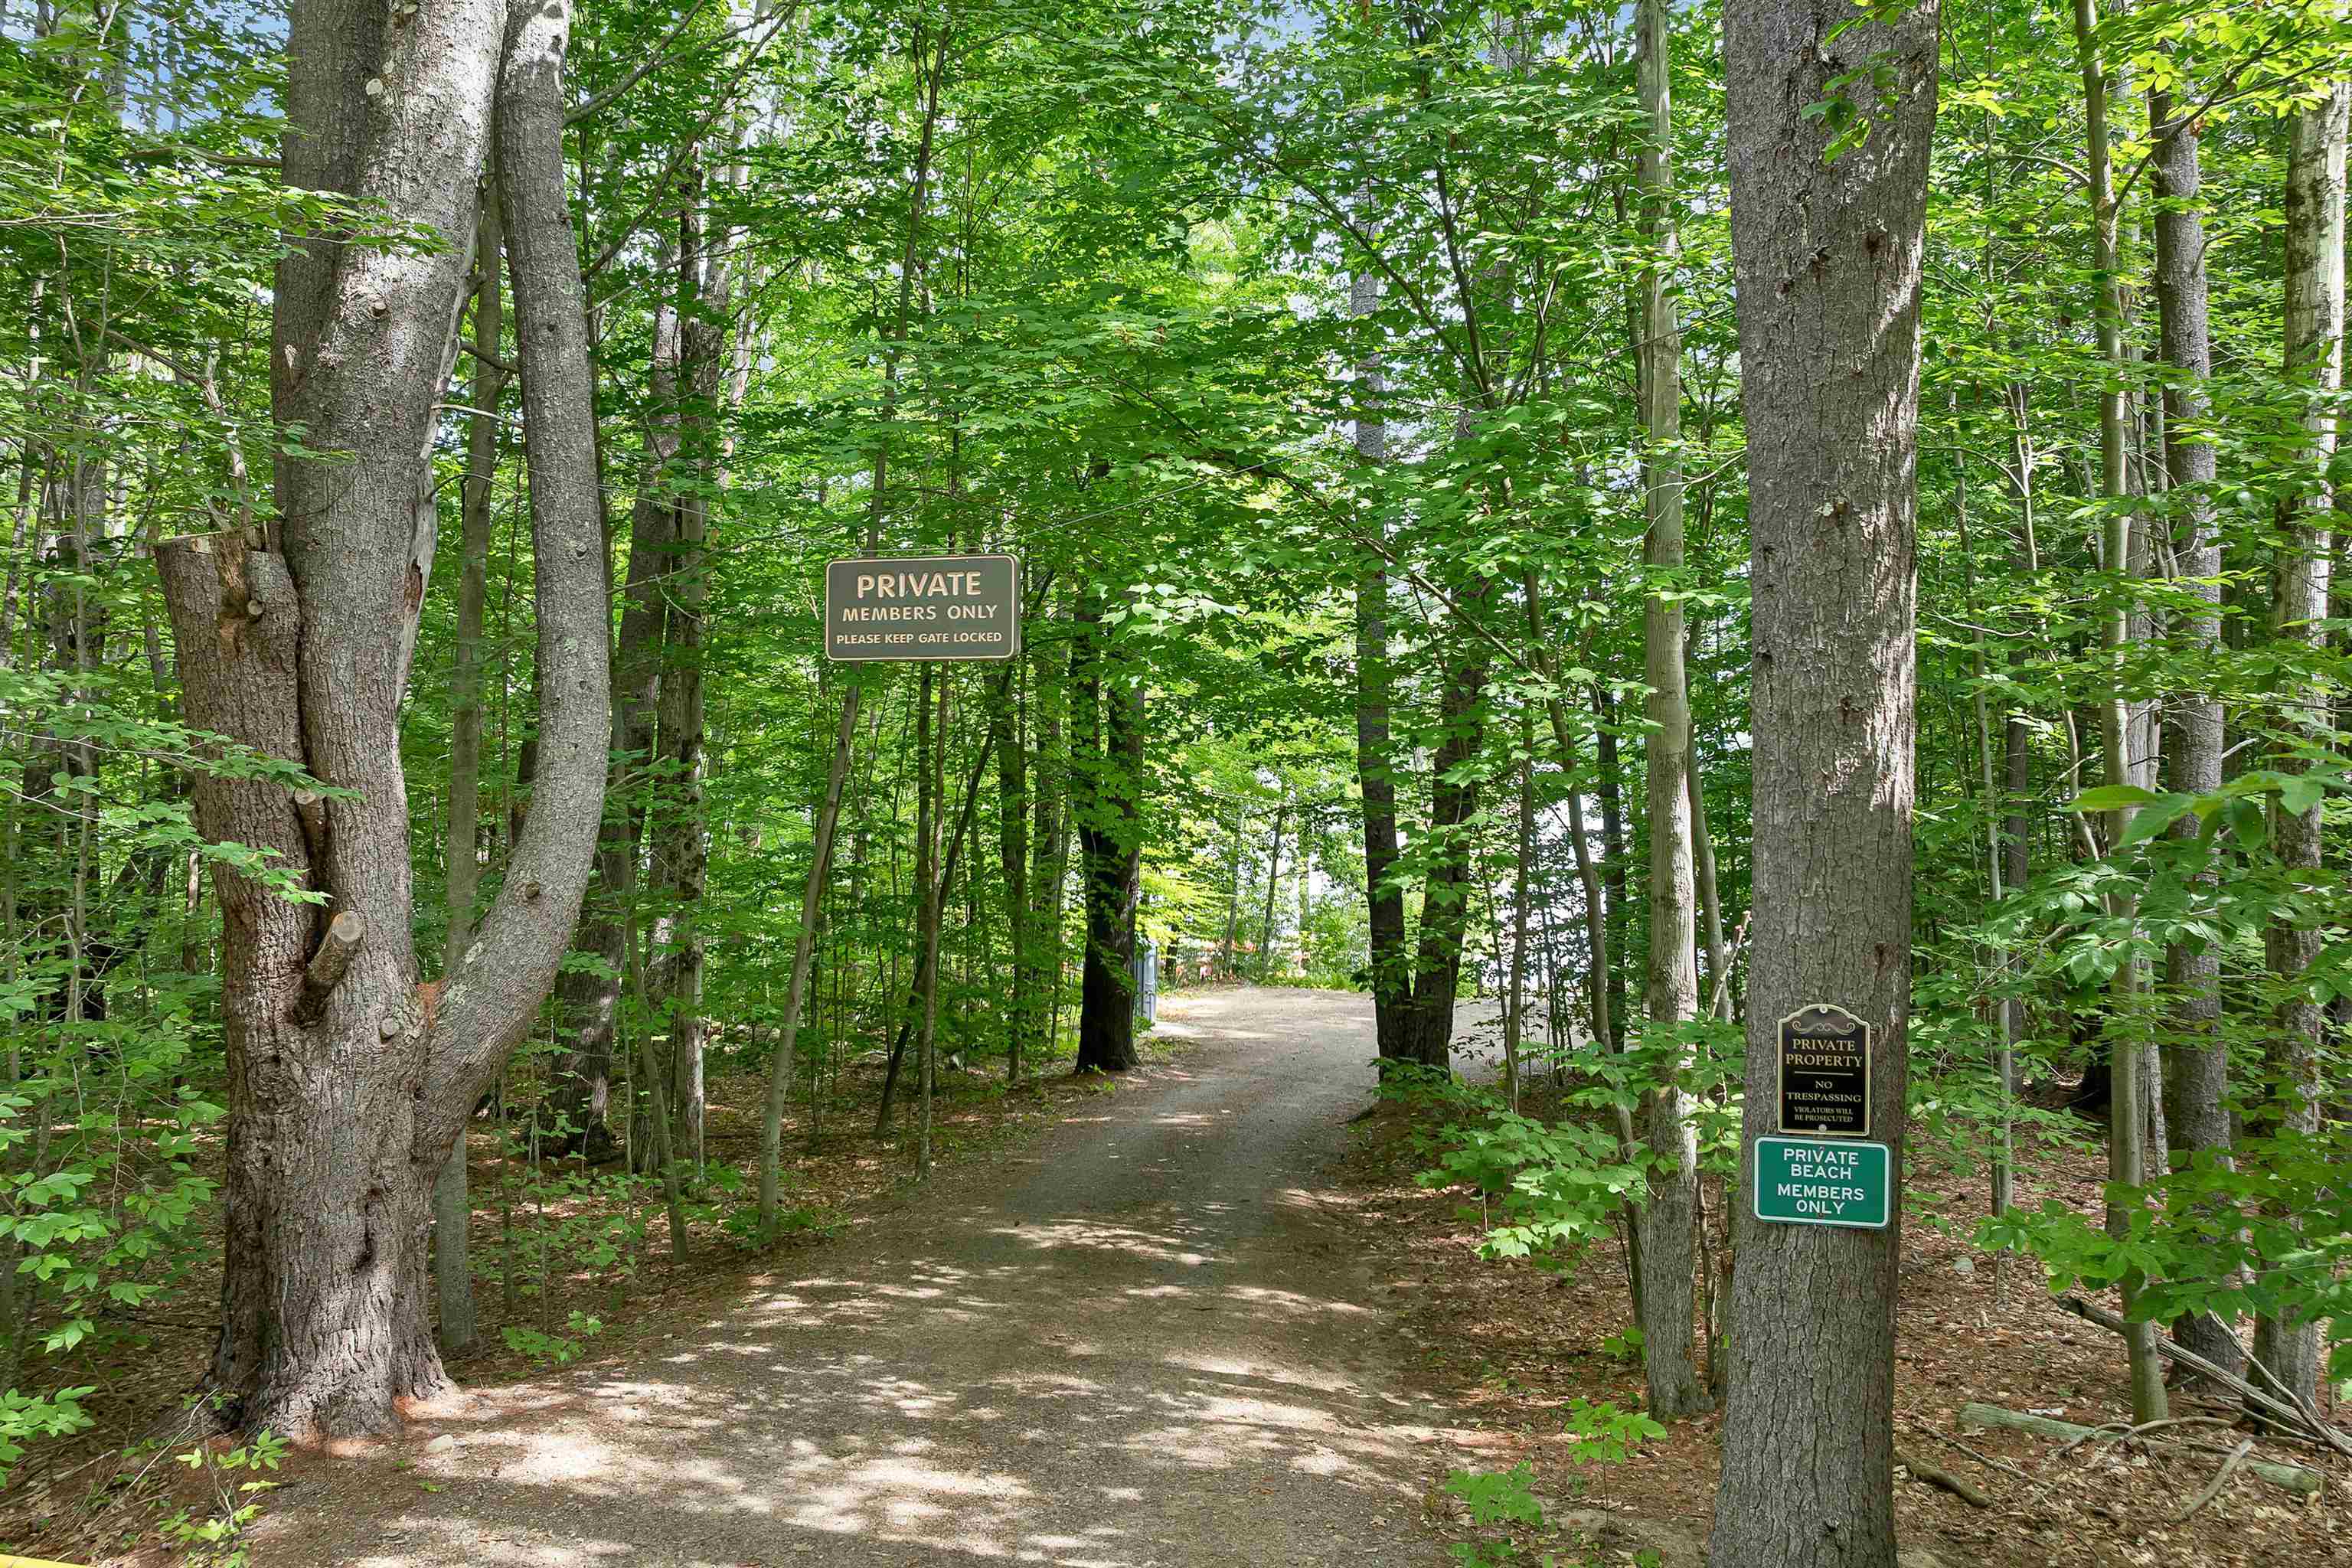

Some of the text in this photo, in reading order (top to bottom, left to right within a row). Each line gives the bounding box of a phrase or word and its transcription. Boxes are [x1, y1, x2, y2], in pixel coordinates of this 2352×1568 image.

[857, 570, 982, 599] PRIVATE
[842, 604, 998, 622] MEMBERS ONLY
[836, 632, 1002, 645] PLEASE KEEP GATE LOCKED
[1792, 1038, 1856, 1051] PRIVATE
[1785, 1054, 1863, 1067] PROPERTY
[1815, 1080, 1833, 1089] NO
[1786, 1092, 1862, 1102] TRESPASSING
[1794, 1106, 1834, 1115] VIOLATORS
[1805, 1114, 1854, 1122] PROSECUTED
[1783, 1148, 1859, 1165] PRIVATE
[1791, 1164, 1851, 1180] BEACH
[1777, 1183, 1864, 1201] MEMBERS
[1796, 1199, 1846, 1214] ONLY
